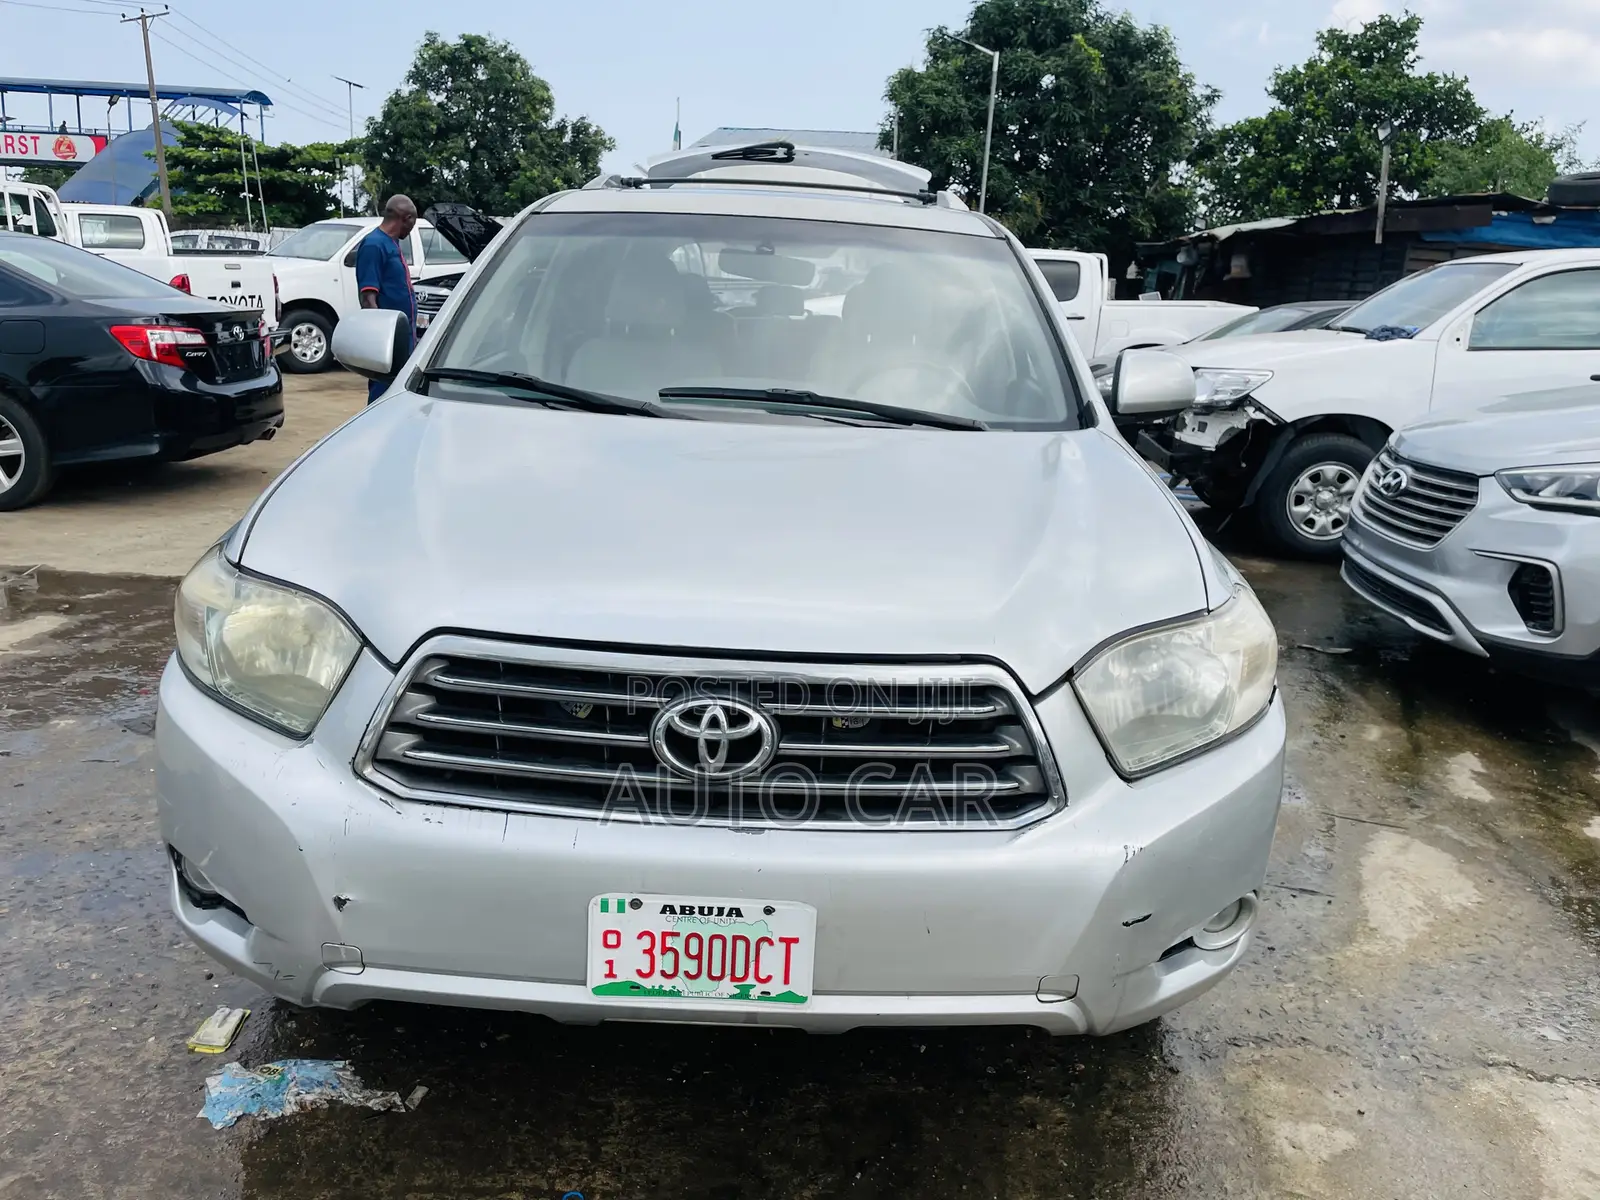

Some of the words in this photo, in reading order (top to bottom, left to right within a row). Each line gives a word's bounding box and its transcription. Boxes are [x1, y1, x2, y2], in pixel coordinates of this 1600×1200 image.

[0, 134, 40, 155] RST
[207, 294, 263, 308] YOTA
[659, 904, 744, 918] ABUJA
[665, 915, 698, 924] CENTRE
[700, 917, 711, 925] OF
[713, 917, 738, 925] UNITY
[635, 930, 800, 985] 3590DCT
